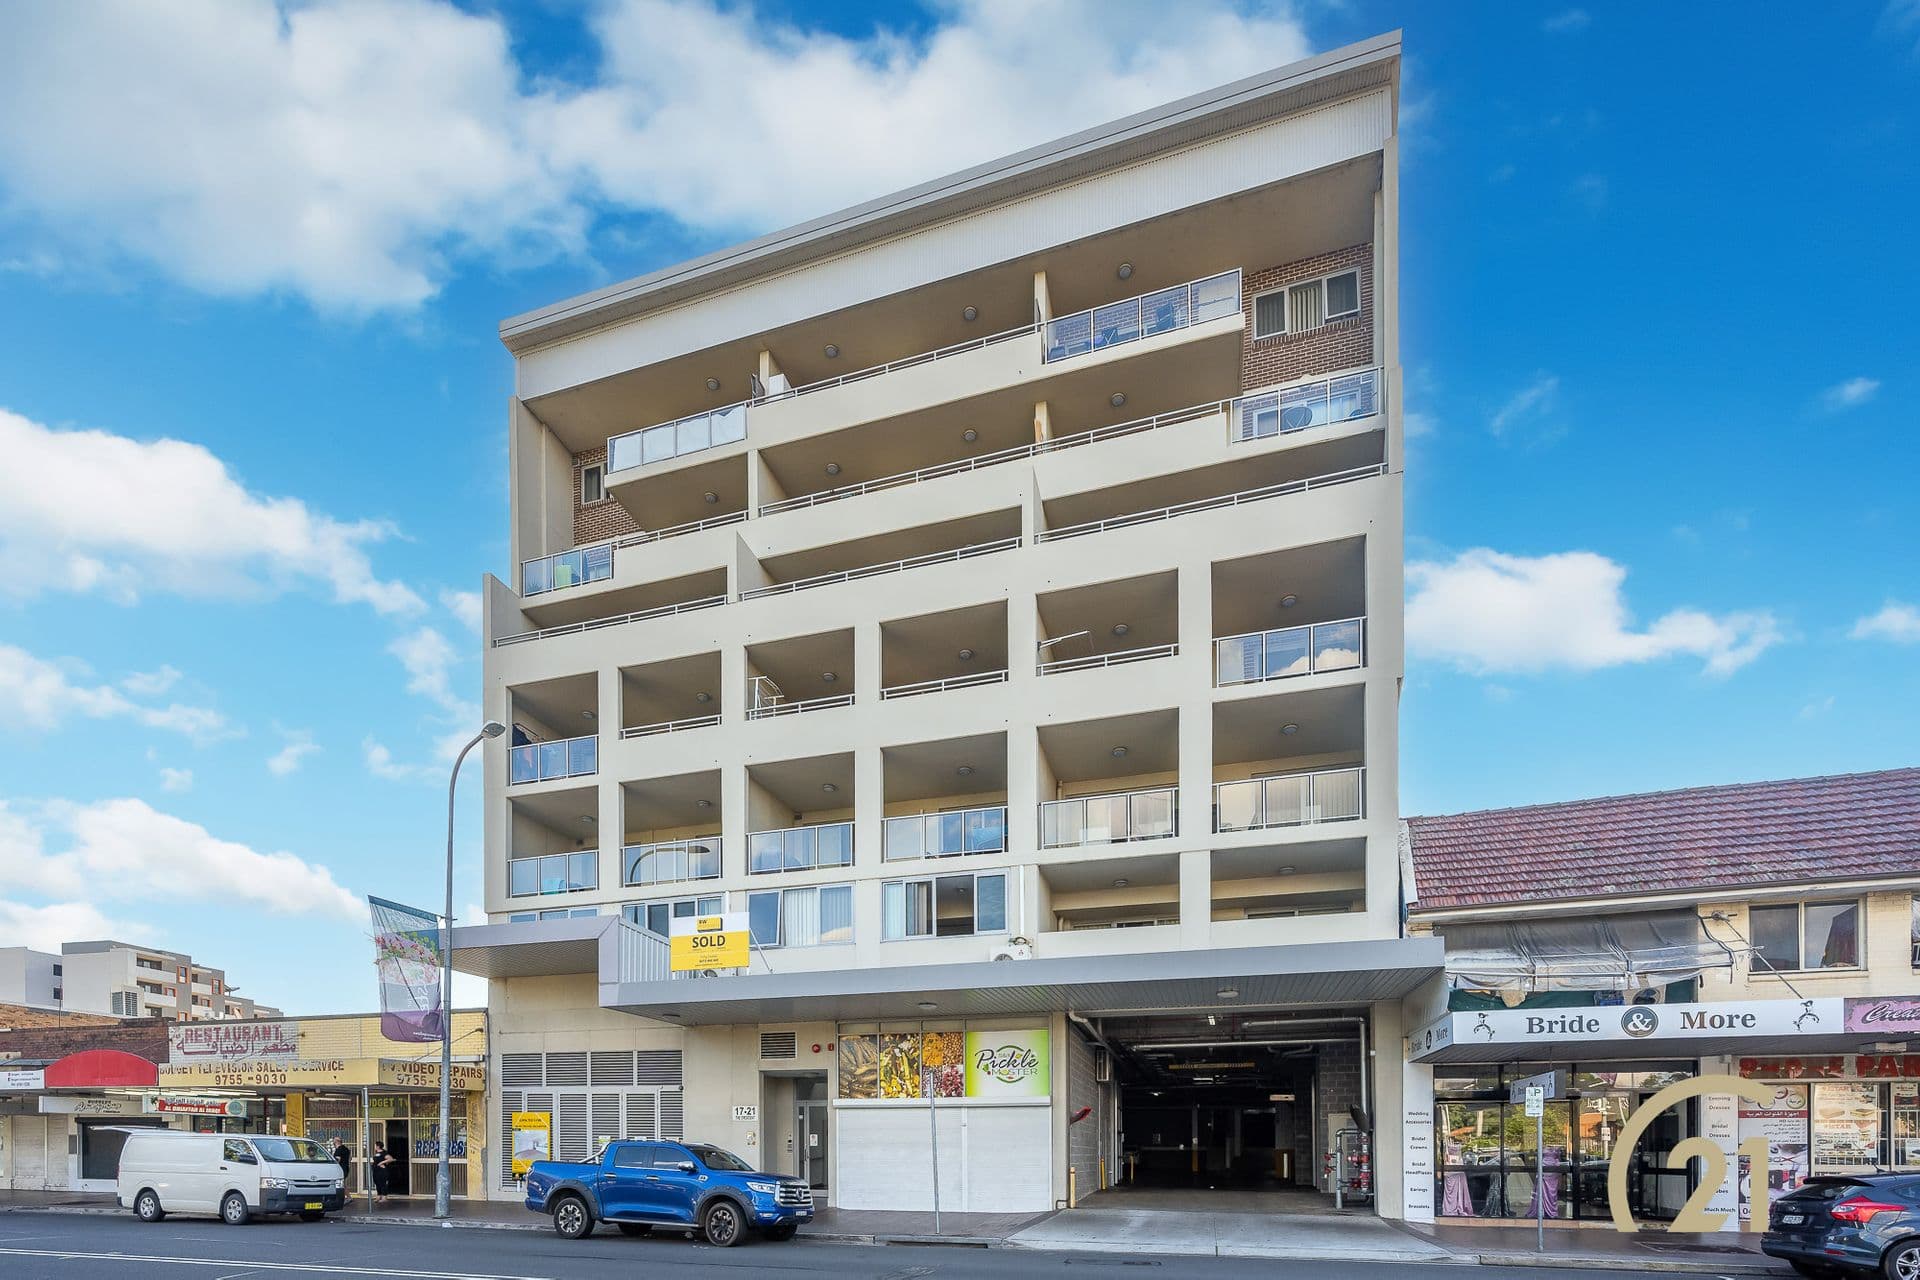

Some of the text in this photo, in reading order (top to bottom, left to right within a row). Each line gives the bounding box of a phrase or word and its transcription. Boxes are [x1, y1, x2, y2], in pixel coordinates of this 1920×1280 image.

[692, 935, 726, 948] SOLD
[1526, 1011, 1756, 1034] Bride & More
[185, 1025, 282, 1043] RESTAURANT
[975, 1048, 1039, 1069] Pickle
[438, 1065, 483, 1079] PAIRS
[991, 1068, 1038, 1076] MSTER
[369, 1097, 395, 1107] DGET
